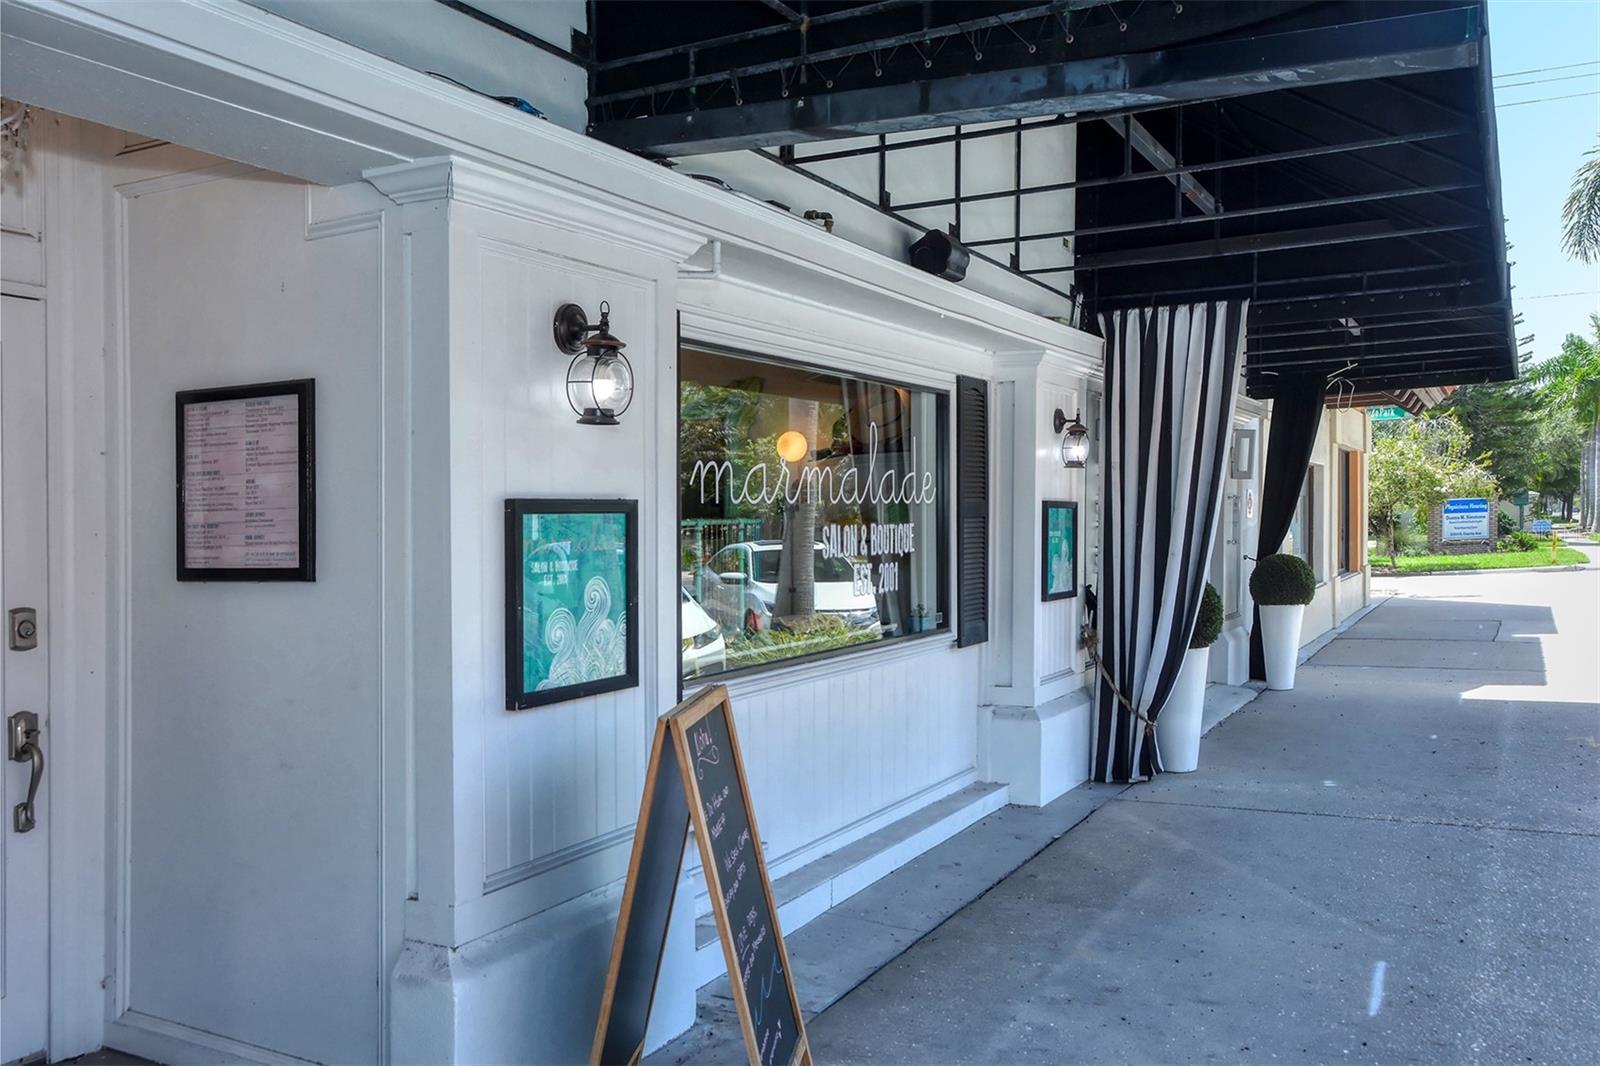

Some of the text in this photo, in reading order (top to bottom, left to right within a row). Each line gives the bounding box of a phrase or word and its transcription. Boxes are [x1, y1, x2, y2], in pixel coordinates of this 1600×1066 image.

[689, 421, 937, 505] marmalade
[822, 522, 915, 560] SALON & BOUTIQUE
[853, 561, 899, 598] EST. 2001
